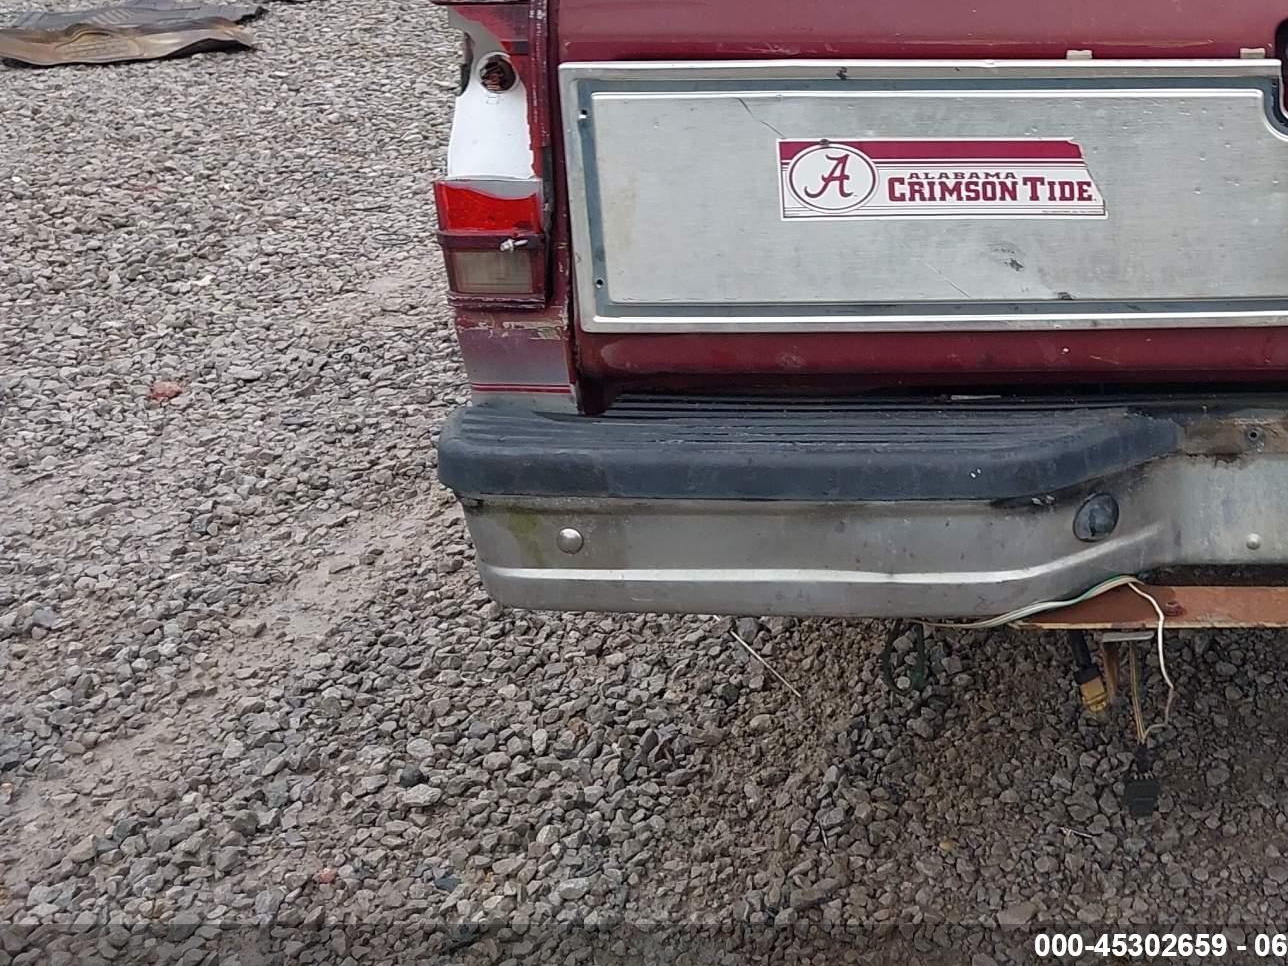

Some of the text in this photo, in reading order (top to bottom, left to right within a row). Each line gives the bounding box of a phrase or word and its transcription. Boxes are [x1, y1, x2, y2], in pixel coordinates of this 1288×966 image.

[907, 171, 1018, 180] ALABAMA
[887, 176, 1094, 202] CRIMSON TIDE
